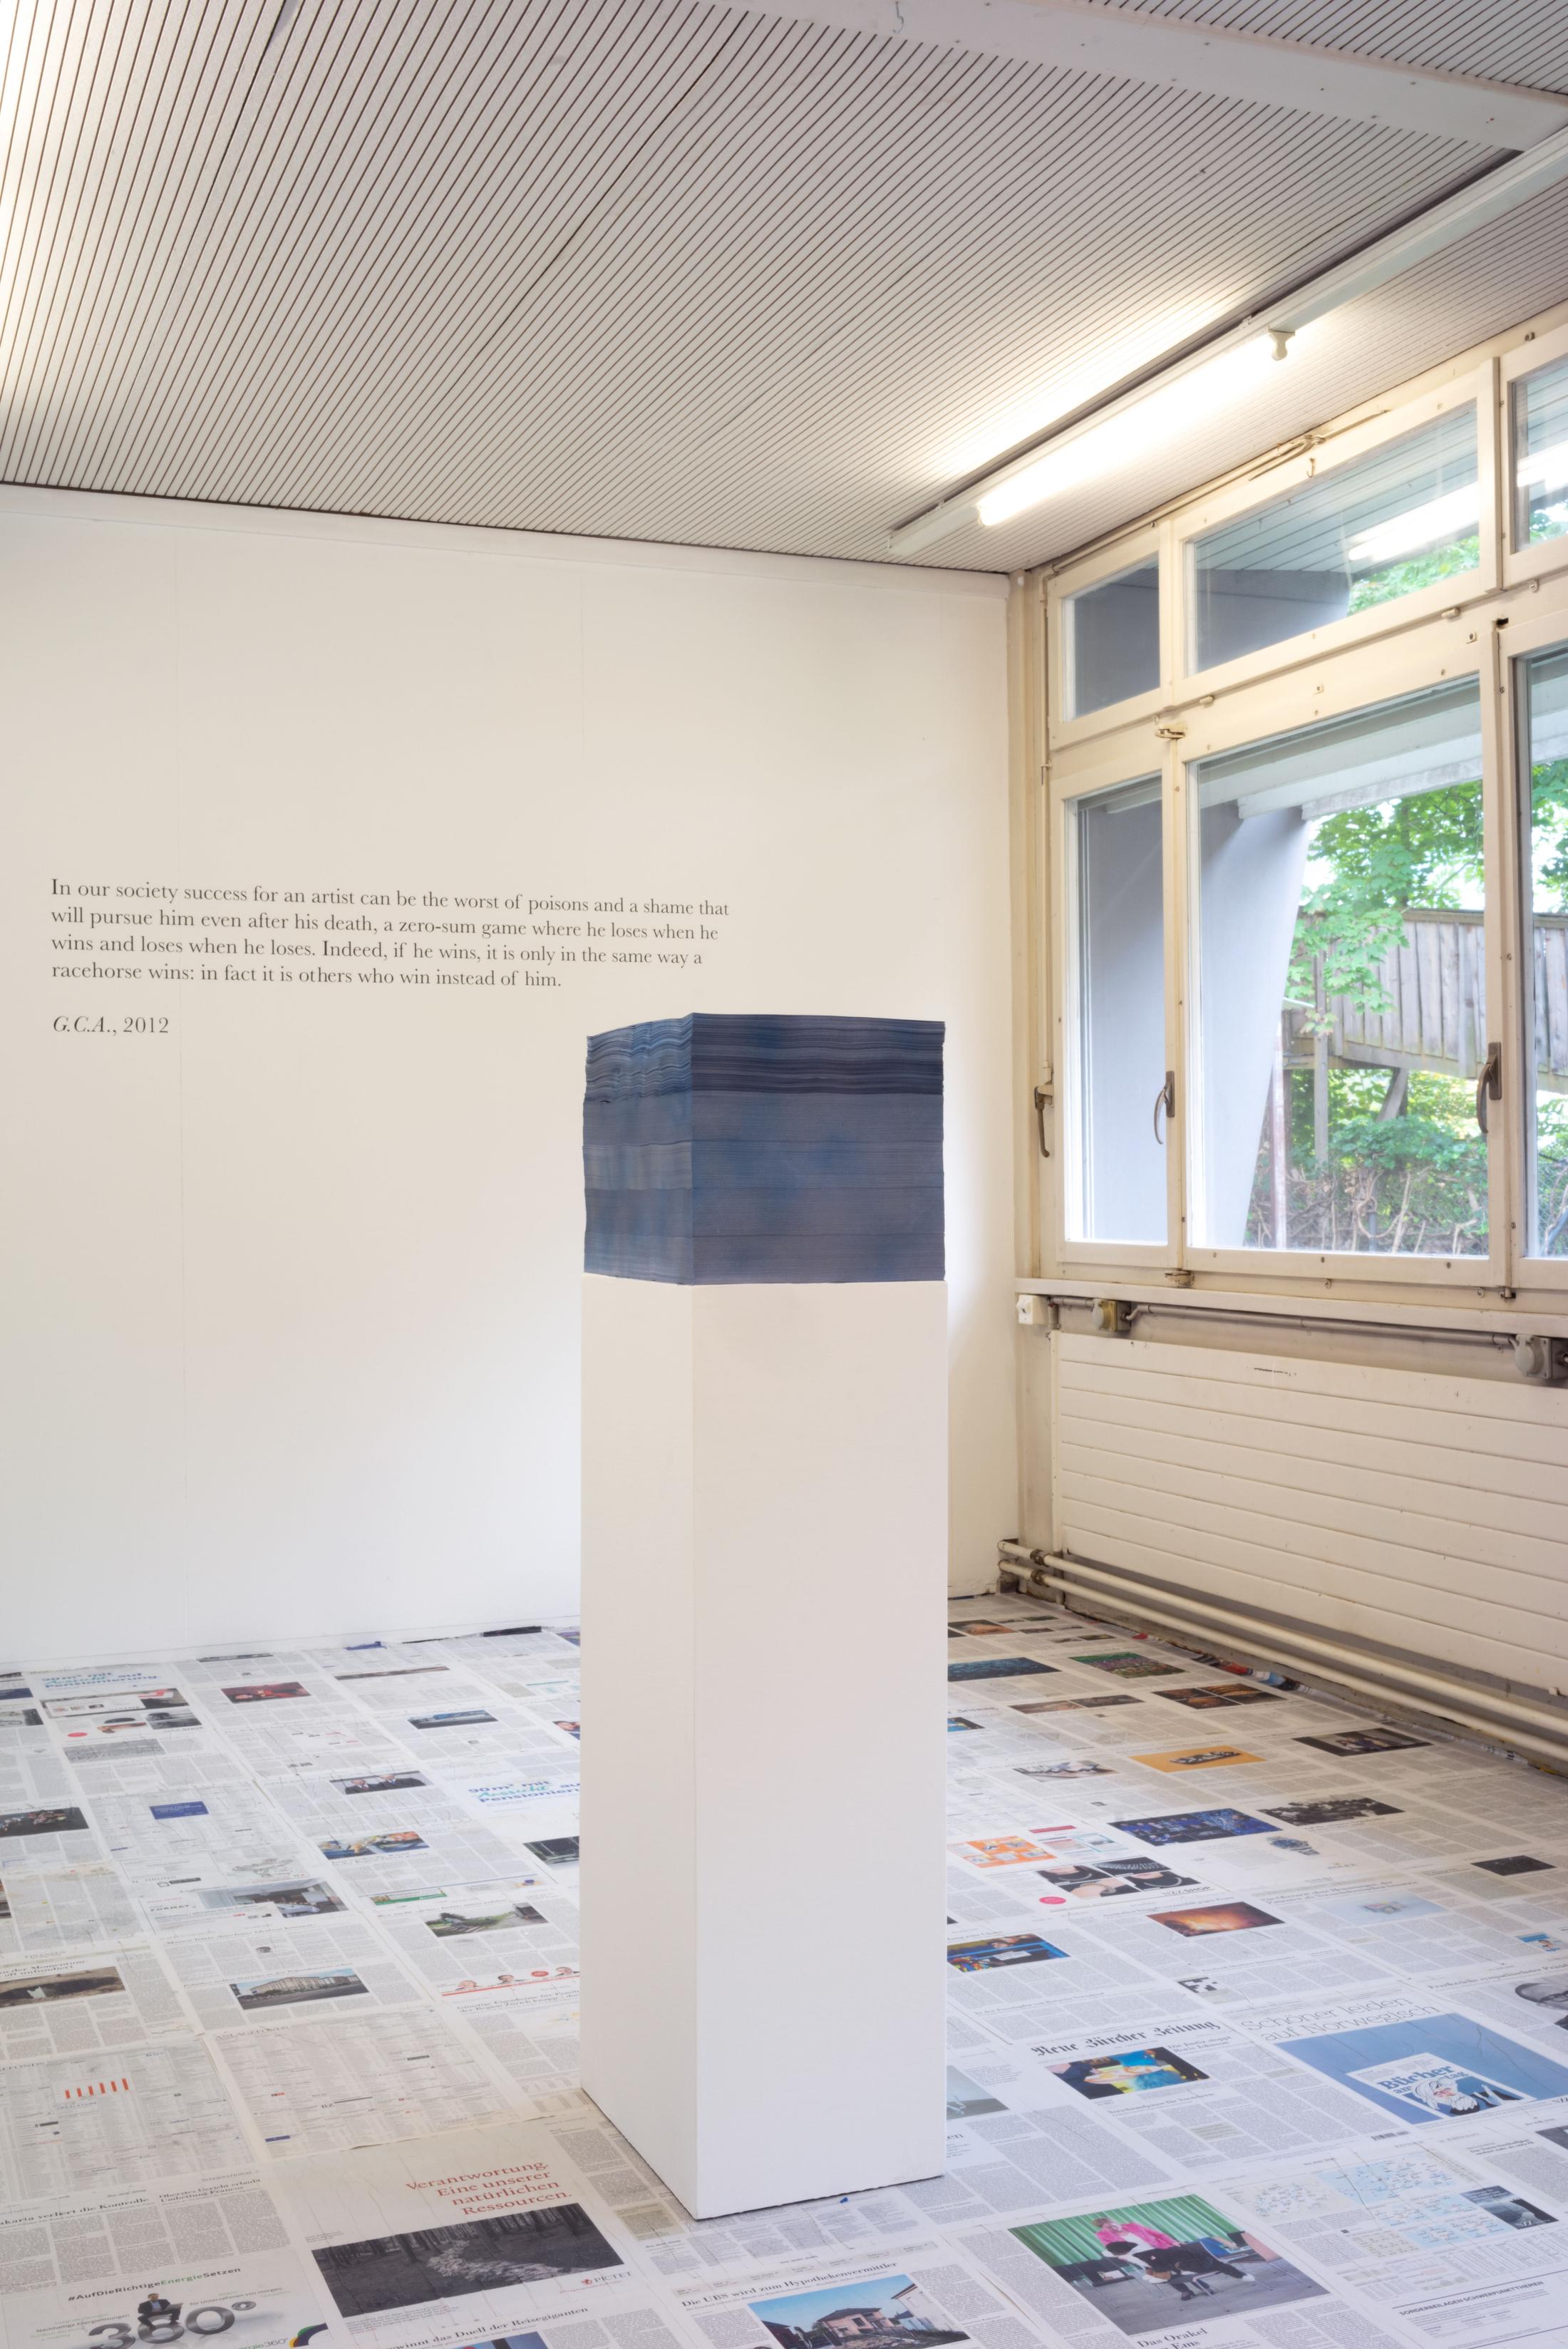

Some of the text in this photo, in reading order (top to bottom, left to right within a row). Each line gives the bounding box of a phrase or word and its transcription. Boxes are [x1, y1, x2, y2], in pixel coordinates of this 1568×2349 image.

[51, 878, 729, 916] In our society success for an artist can be the worst of poisons and a shame that
[51, 906, 718, 940] will pursue him even after his death, a zero-sum game where he loses when he
[51, 933, 703, 969] wins and loses when he loses. Indeed, if he wins, it is only in the same way a
[51, 961, 562, 987] racehorse wins: in fact it is others who win instead of him.
[53, 1015, 169, 1037] G.C.A., 2012
[1241, 1996, 1415, 2030] Schöner leiden
[1260, 2004, 1441, 2041] auf Norwegisch
[1030, 2020, 1221, 2057] Neue Zürcher Zeitung
[1376, 2065, 1455, 2090] Bücher
[405, 2161, 550, 2190] Verantwortung.
[435, 2170, 552, 2197] Eine unserer
[450, 2180, 560, 2206] natürlichen
[460, 2191, 573, 2216] Ressourcen.
[0, 2214, 35, 2225] akarta
[68, 2267, 242, 2302] #AufDieRichtigeEnergieSetzen
[681, 2261, 899, 2308] Die UBS wird zum Hypothekenvermittler
[432, 2333, 453, 2343] das
[453, 2325, 488, 2338] Duell
[489, 2320, 510, 2331] der
[510, 2306, 589, 2327] Reisegiganten
[1136, 2327, 1209, 2348] Das Orakel
